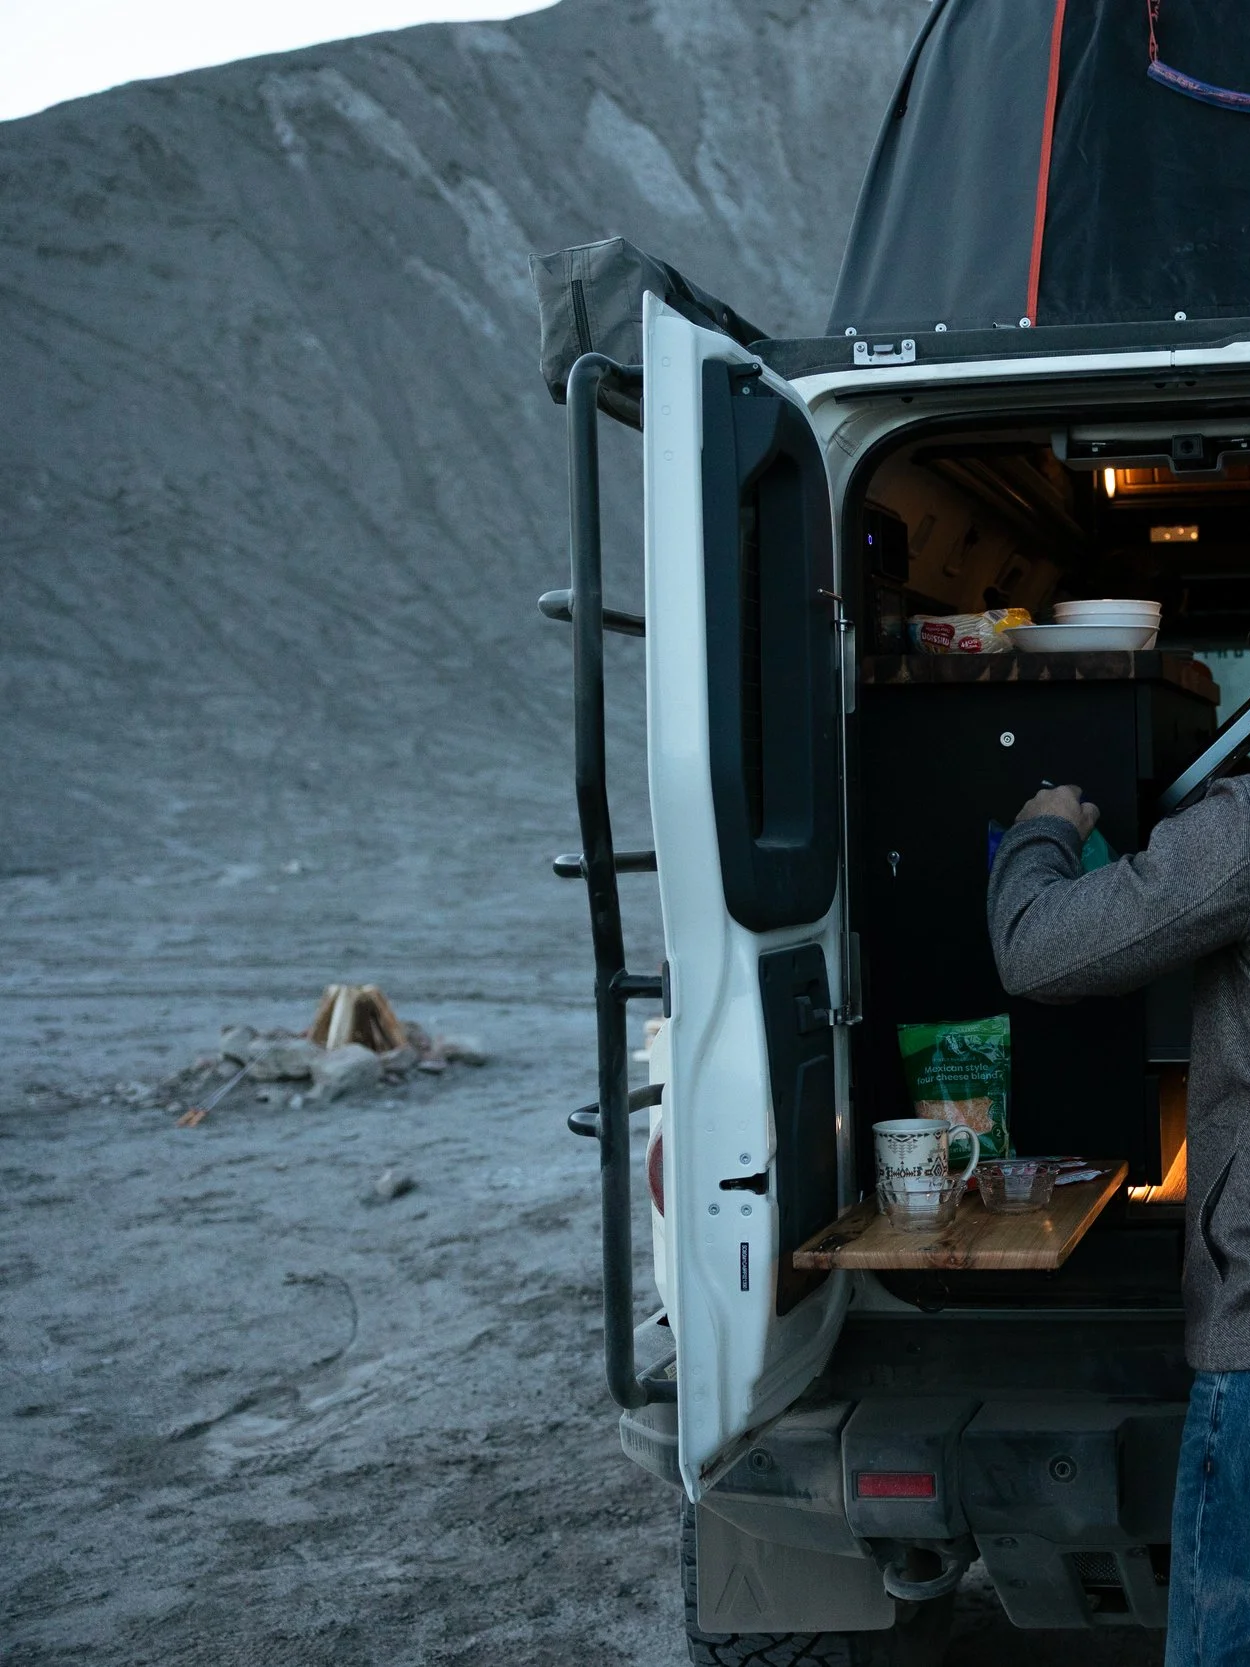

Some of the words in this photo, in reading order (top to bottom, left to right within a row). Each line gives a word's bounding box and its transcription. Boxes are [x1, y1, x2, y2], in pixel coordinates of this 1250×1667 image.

[924, 1063, 963, 1074] Mexican
[966, 1063, 989, 1073] style
[917, 1075, 935, 1085] four
[936, 1073, 969, 1081] cheese
[971, 1071, 998, 1081] blend
